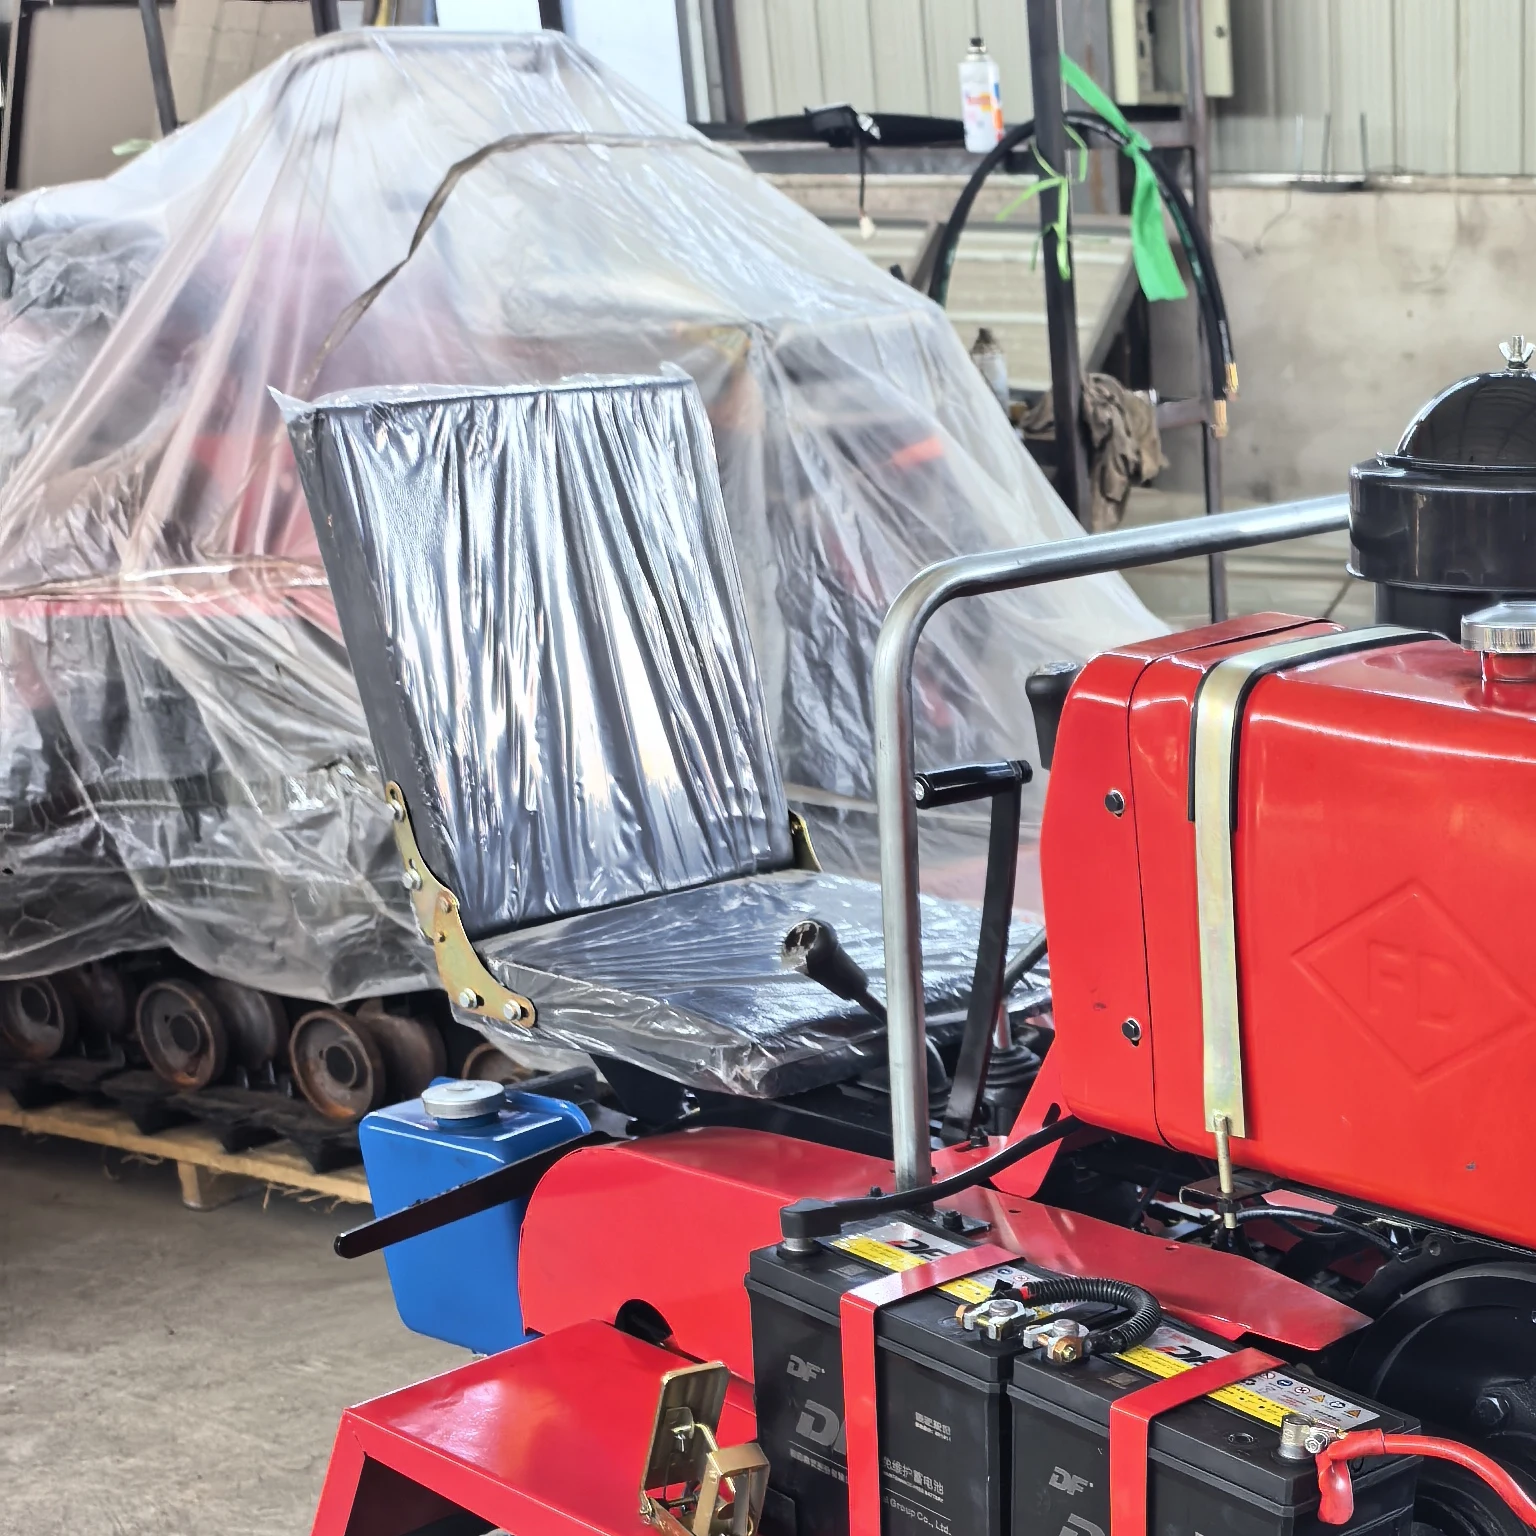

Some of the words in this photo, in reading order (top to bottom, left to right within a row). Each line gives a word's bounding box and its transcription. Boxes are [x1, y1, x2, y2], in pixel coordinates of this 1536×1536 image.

[1049, 1466, 1089, 1495] DF
[890, 1498, 916, 1518] Group
[935, 1519, 952, 1536] Ltd.
